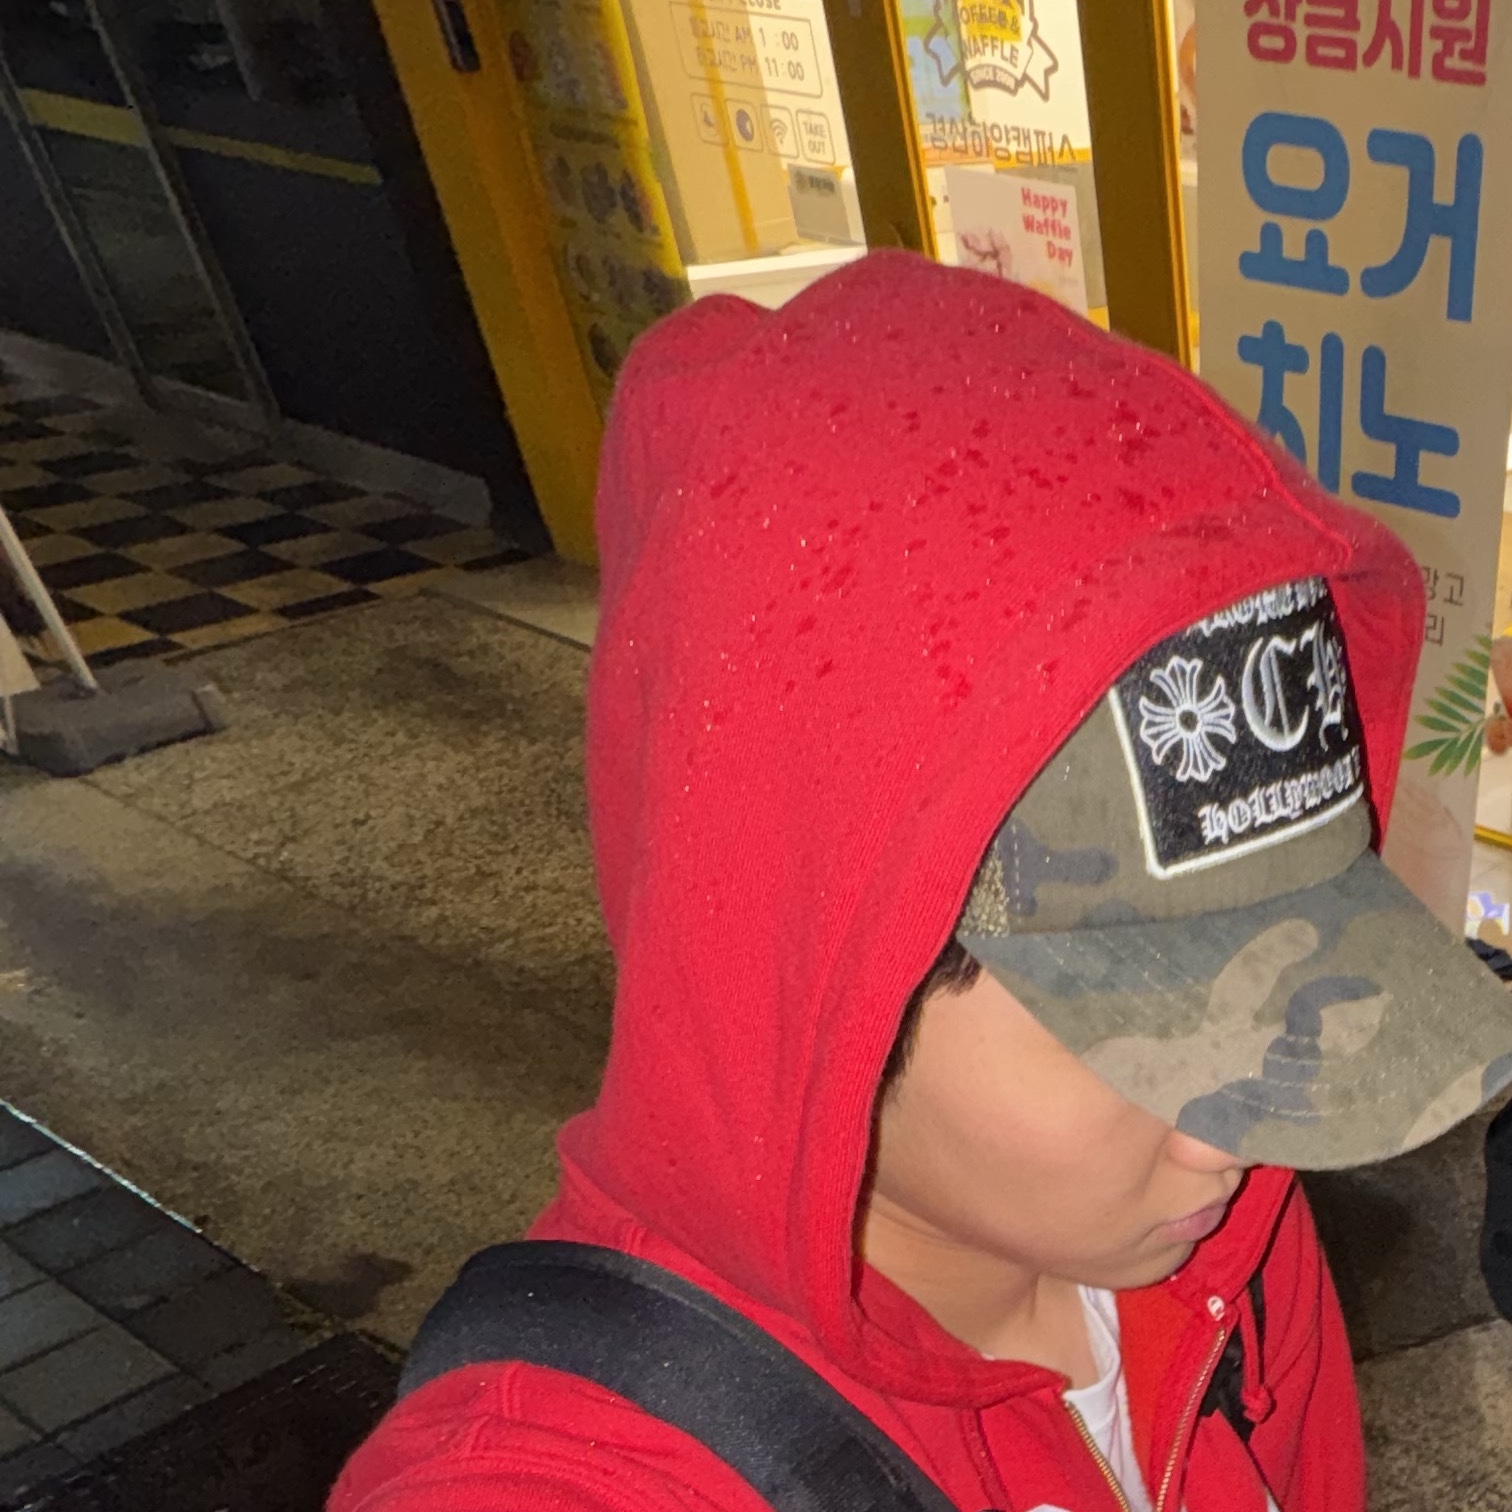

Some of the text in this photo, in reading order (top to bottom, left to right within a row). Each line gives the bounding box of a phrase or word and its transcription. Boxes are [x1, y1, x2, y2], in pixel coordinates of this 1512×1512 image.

[802, 121, 826, 137] TAKE
[807, 140, 826, 155] OUT
[1021, 187, 1067, 218] Happy
[1022, 214, 1072, 241] Waffle
[1238, 111, 1484, 323] 요거
[1047, 240, 1073, 269] Day
